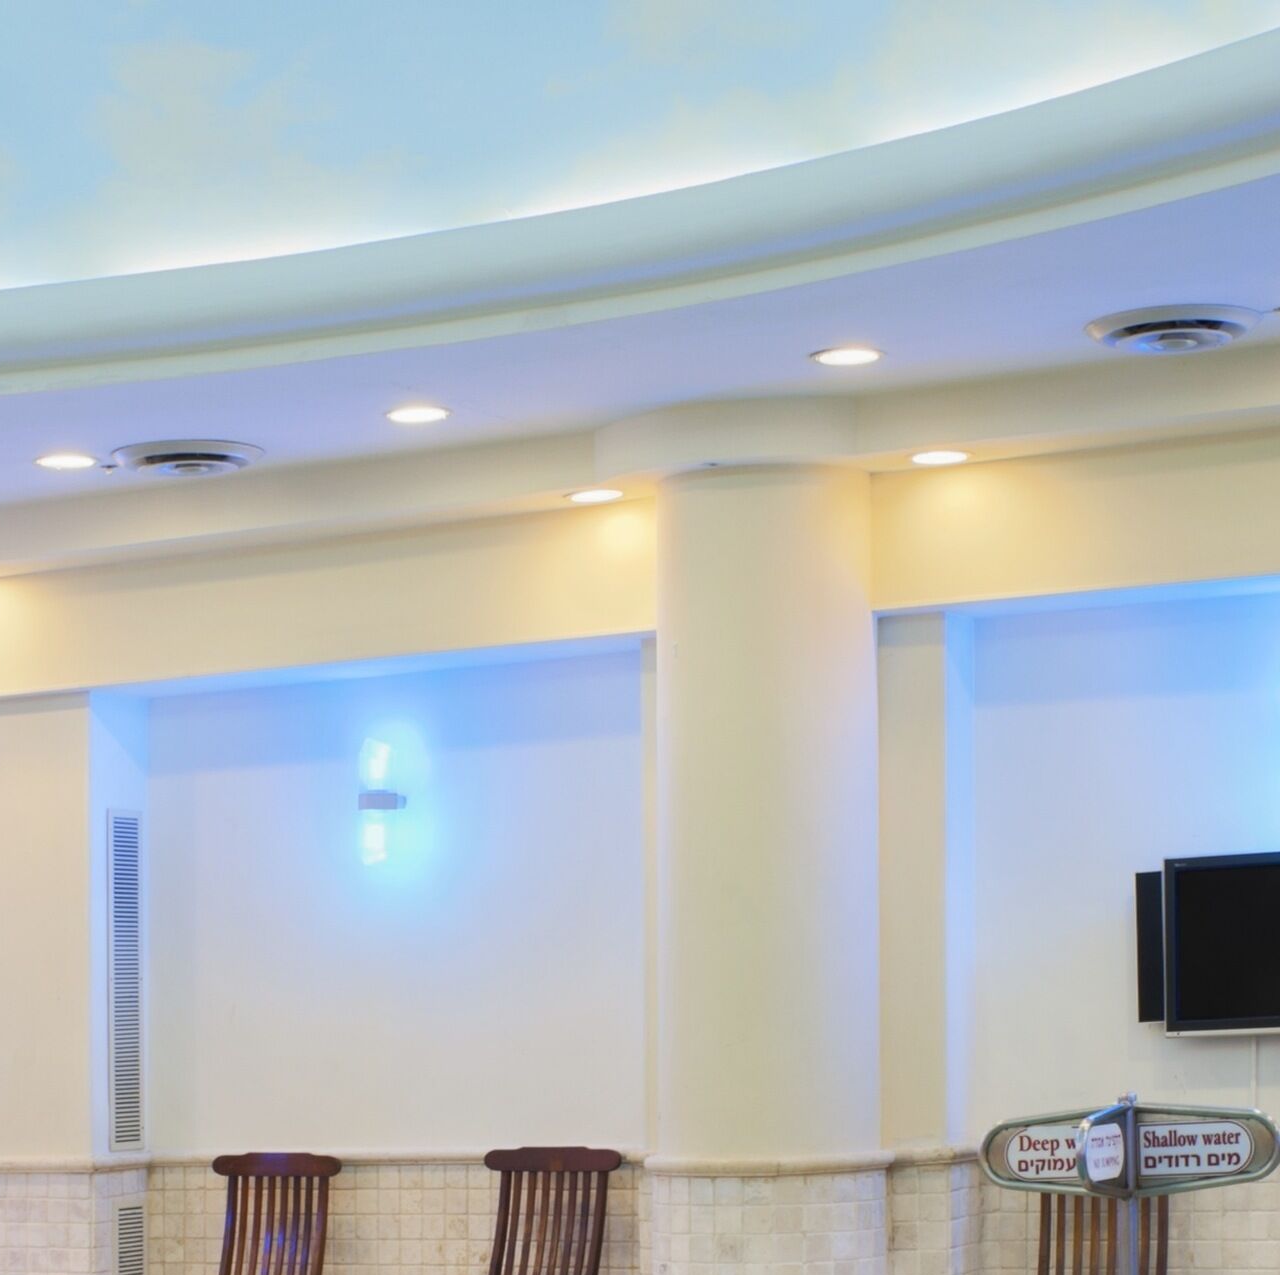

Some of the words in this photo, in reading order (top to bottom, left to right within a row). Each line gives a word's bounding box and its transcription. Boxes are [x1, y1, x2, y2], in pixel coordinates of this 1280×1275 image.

[1019, 1135, 1059, 1156] Deep
[1144, 1130, 1197, 1148] Shallow
[1202, 1132, 1240, 1145] water
[1144, 1154, 1200, 1168] רדודים
[1207, 1152, 1240, 1166] מים
